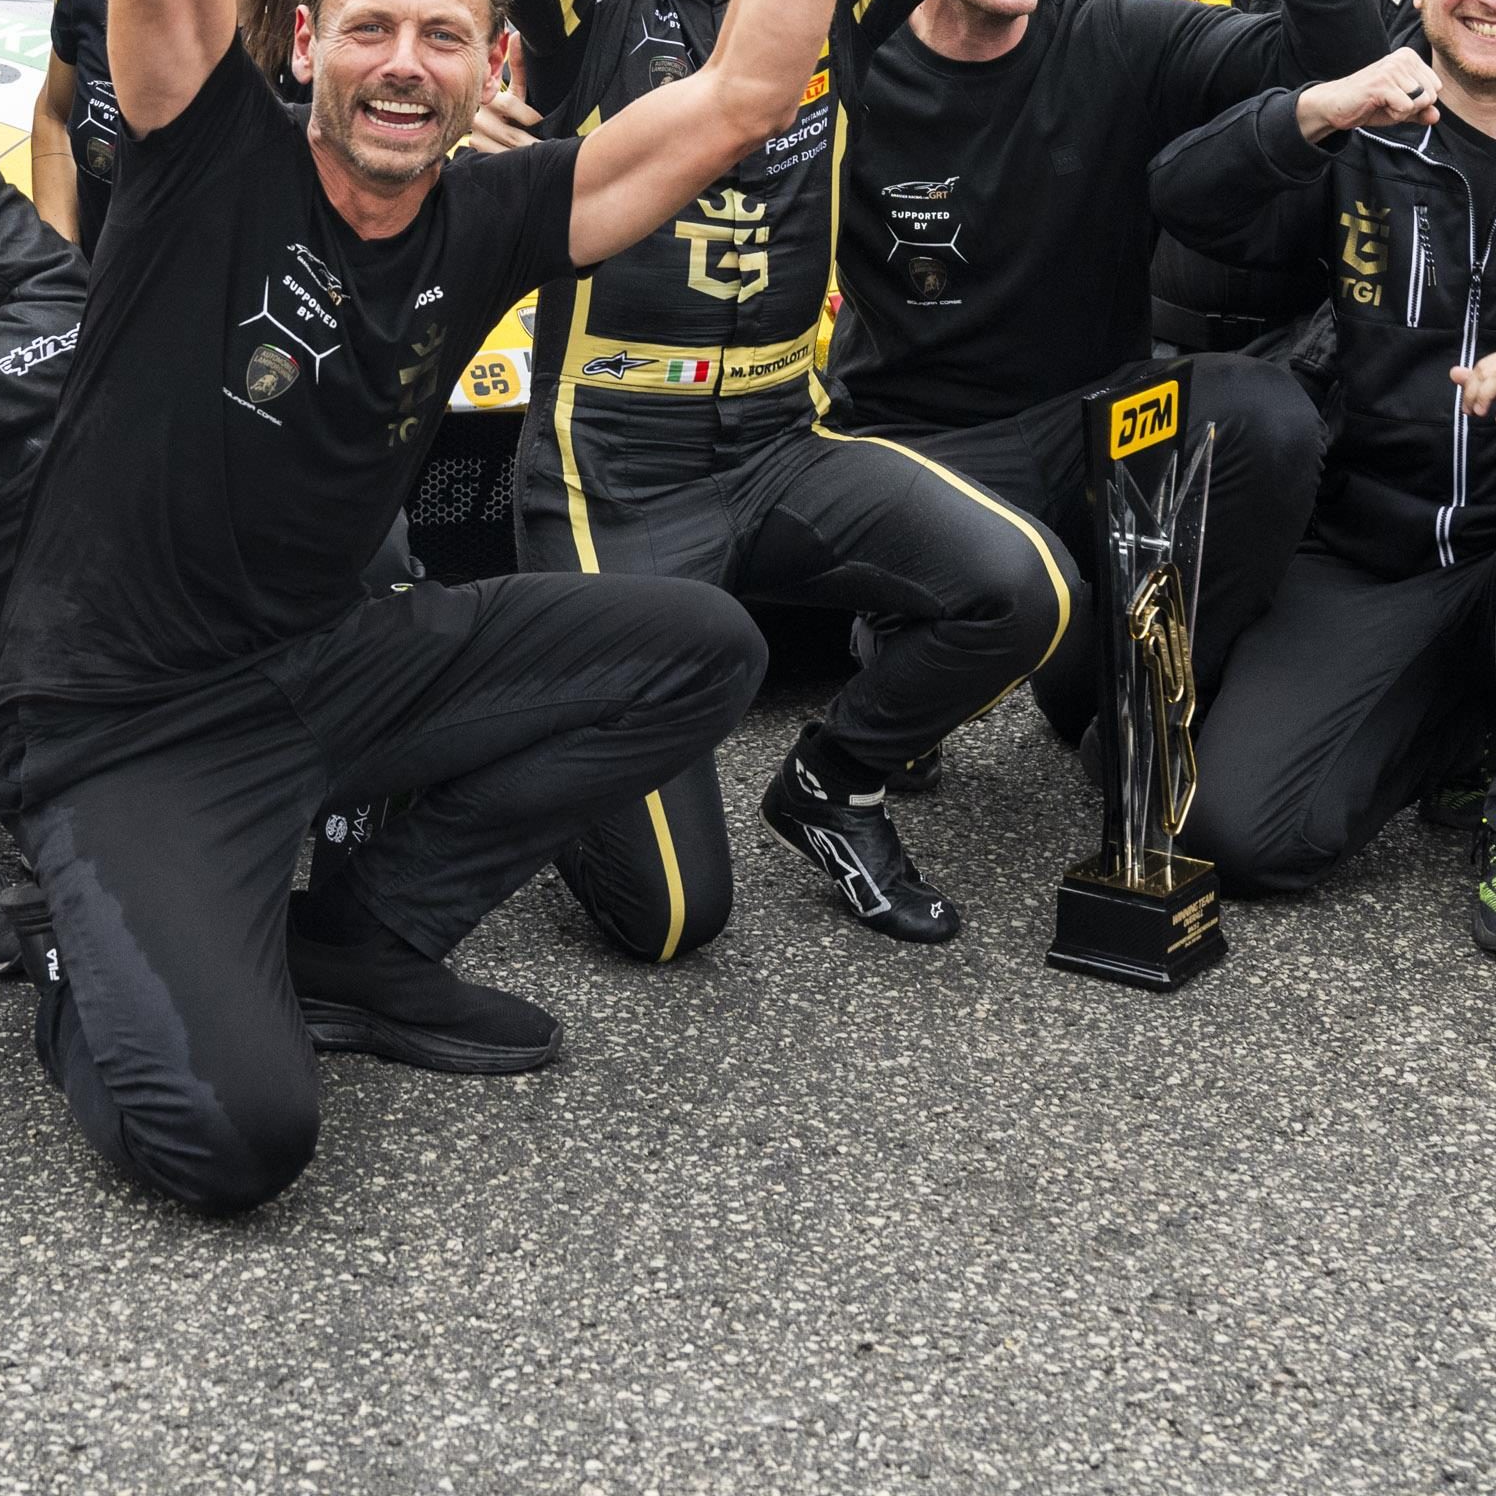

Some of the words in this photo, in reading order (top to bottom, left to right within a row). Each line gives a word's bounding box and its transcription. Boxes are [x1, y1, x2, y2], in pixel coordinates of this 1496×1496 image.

[669, 20, 681, 30] BY
[103, 112, 116, 122] BY
[765, 116, 828, 155] Fastron
[766, 155, 800, 177] ROGER
[928, 190, 949, 201] GRT
[890, 210, 951, 221] SUPPORTED
[914, 221, 928, 231] BY
[414, 285, 444, 310] OSS
[1340, 277, 1383, 307] TGI
[282, 274, 338, 330] SUPPORTED
[296, 306, 315, 323] BY
[729, 365, 747, 379] M.
[1118, 389, 1177, 449] DTM
[1198, 890, 1215, 908] TEAM
[46, 948, 61, 982] FILA
